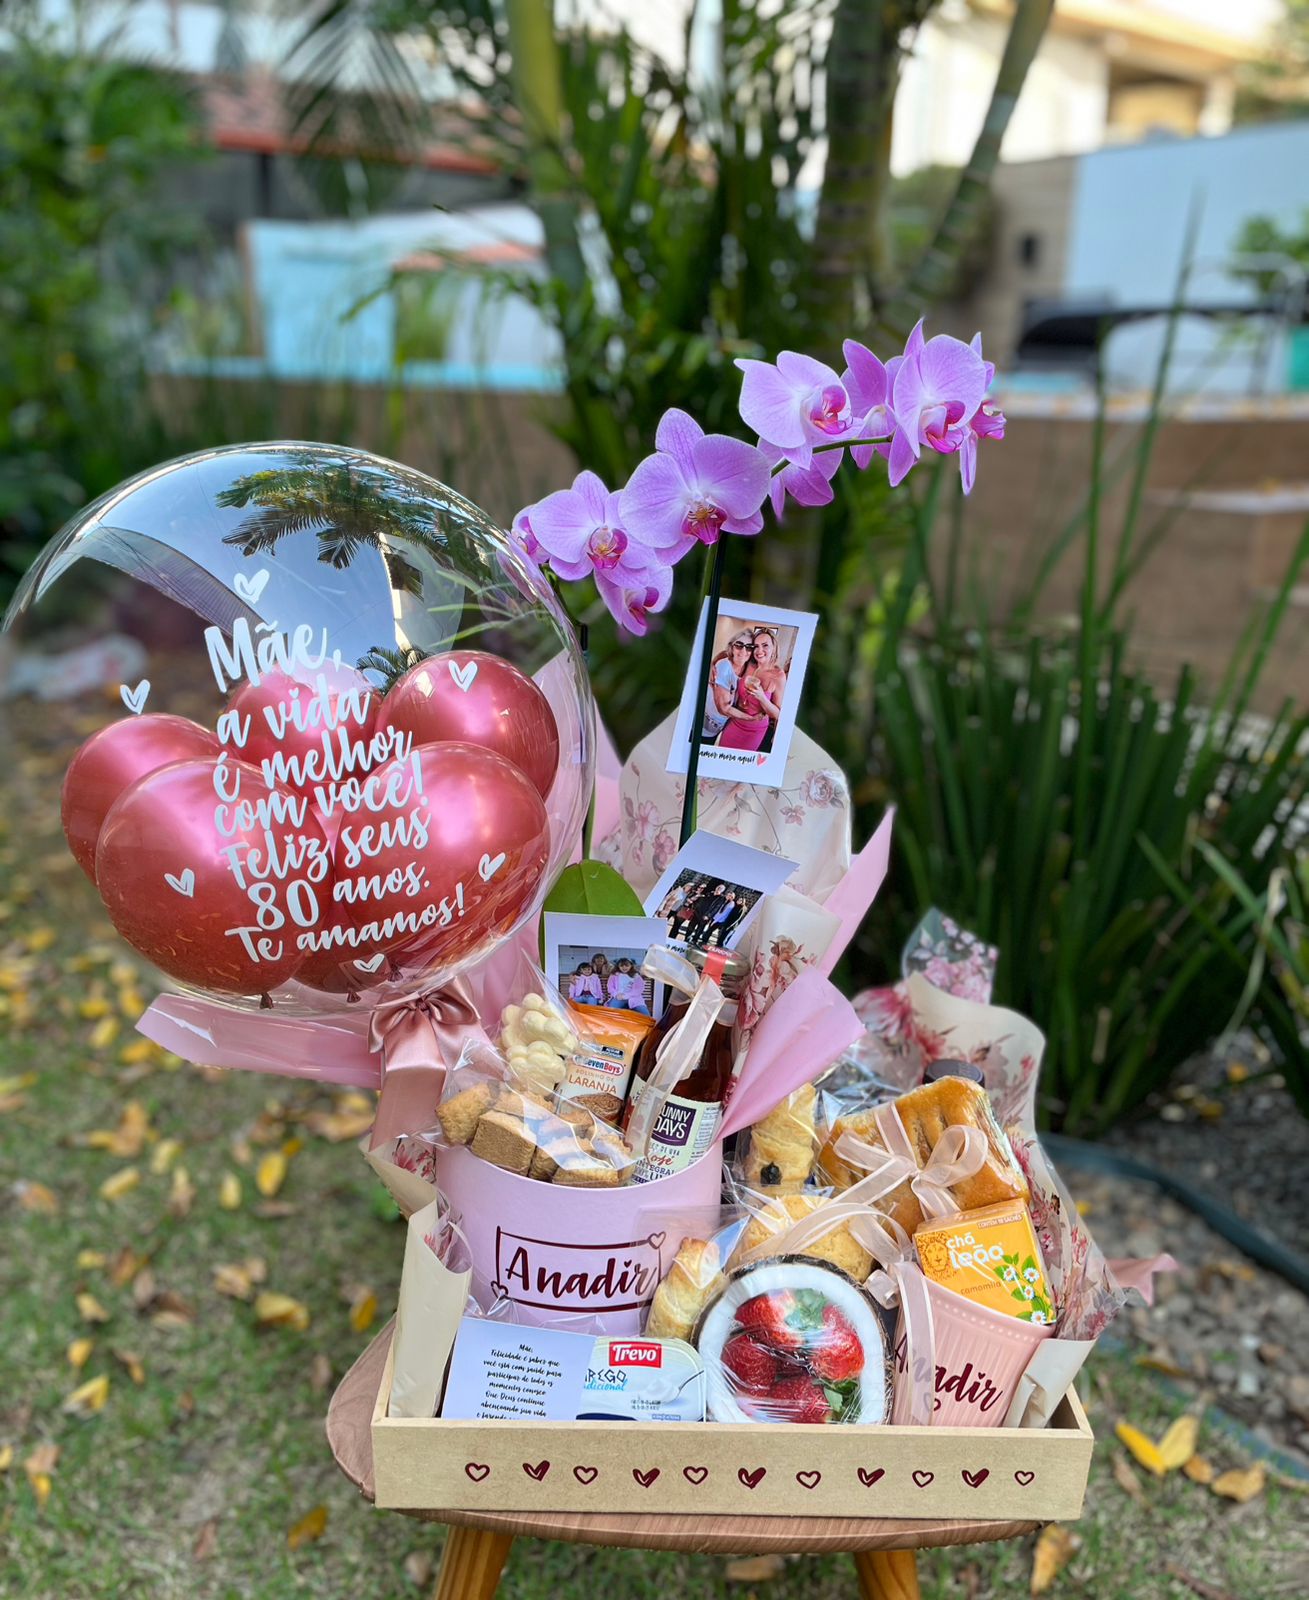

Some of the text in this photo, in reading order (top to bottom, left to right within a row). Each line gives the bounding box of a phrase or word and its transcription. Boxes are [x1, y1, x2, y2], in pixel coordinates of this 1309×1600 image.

[204, 617, 341, 693] Mãe,
[216, 673, 370, 748] a vida
[213, 725, 412, 802] é melhor
[214, 750, 428, 837] com você!
[219, 807, 432, 890] Feliz seus
[248, 861, 430, 931] 80 anos.
[224, 882, 465, 963] Te amamos!
[568, 1074, 617, 1094] LARANJA
[661, 1104, 691, 1123] UNNY
[946, 1232, 975, 1249] chá
[949, 1244, 1004, 1269] leão
[505, 1246, 658, 1299] Anadir
[961, 1282, 1001, 1295] camomila
[491, 1349, 521, 1361] Felicidade
[613, 1344, 657, 1362] Trevo
[487, 1371, 520, 1381] participar
[585, 1368, 627, 1383] REGO
[489, 1382, 521, 1393] momentos
[500, 1392, 516, 1402] Deus
[517, 1396, 545, 1406] continue
[533, 1409, 547, 1417] vida
